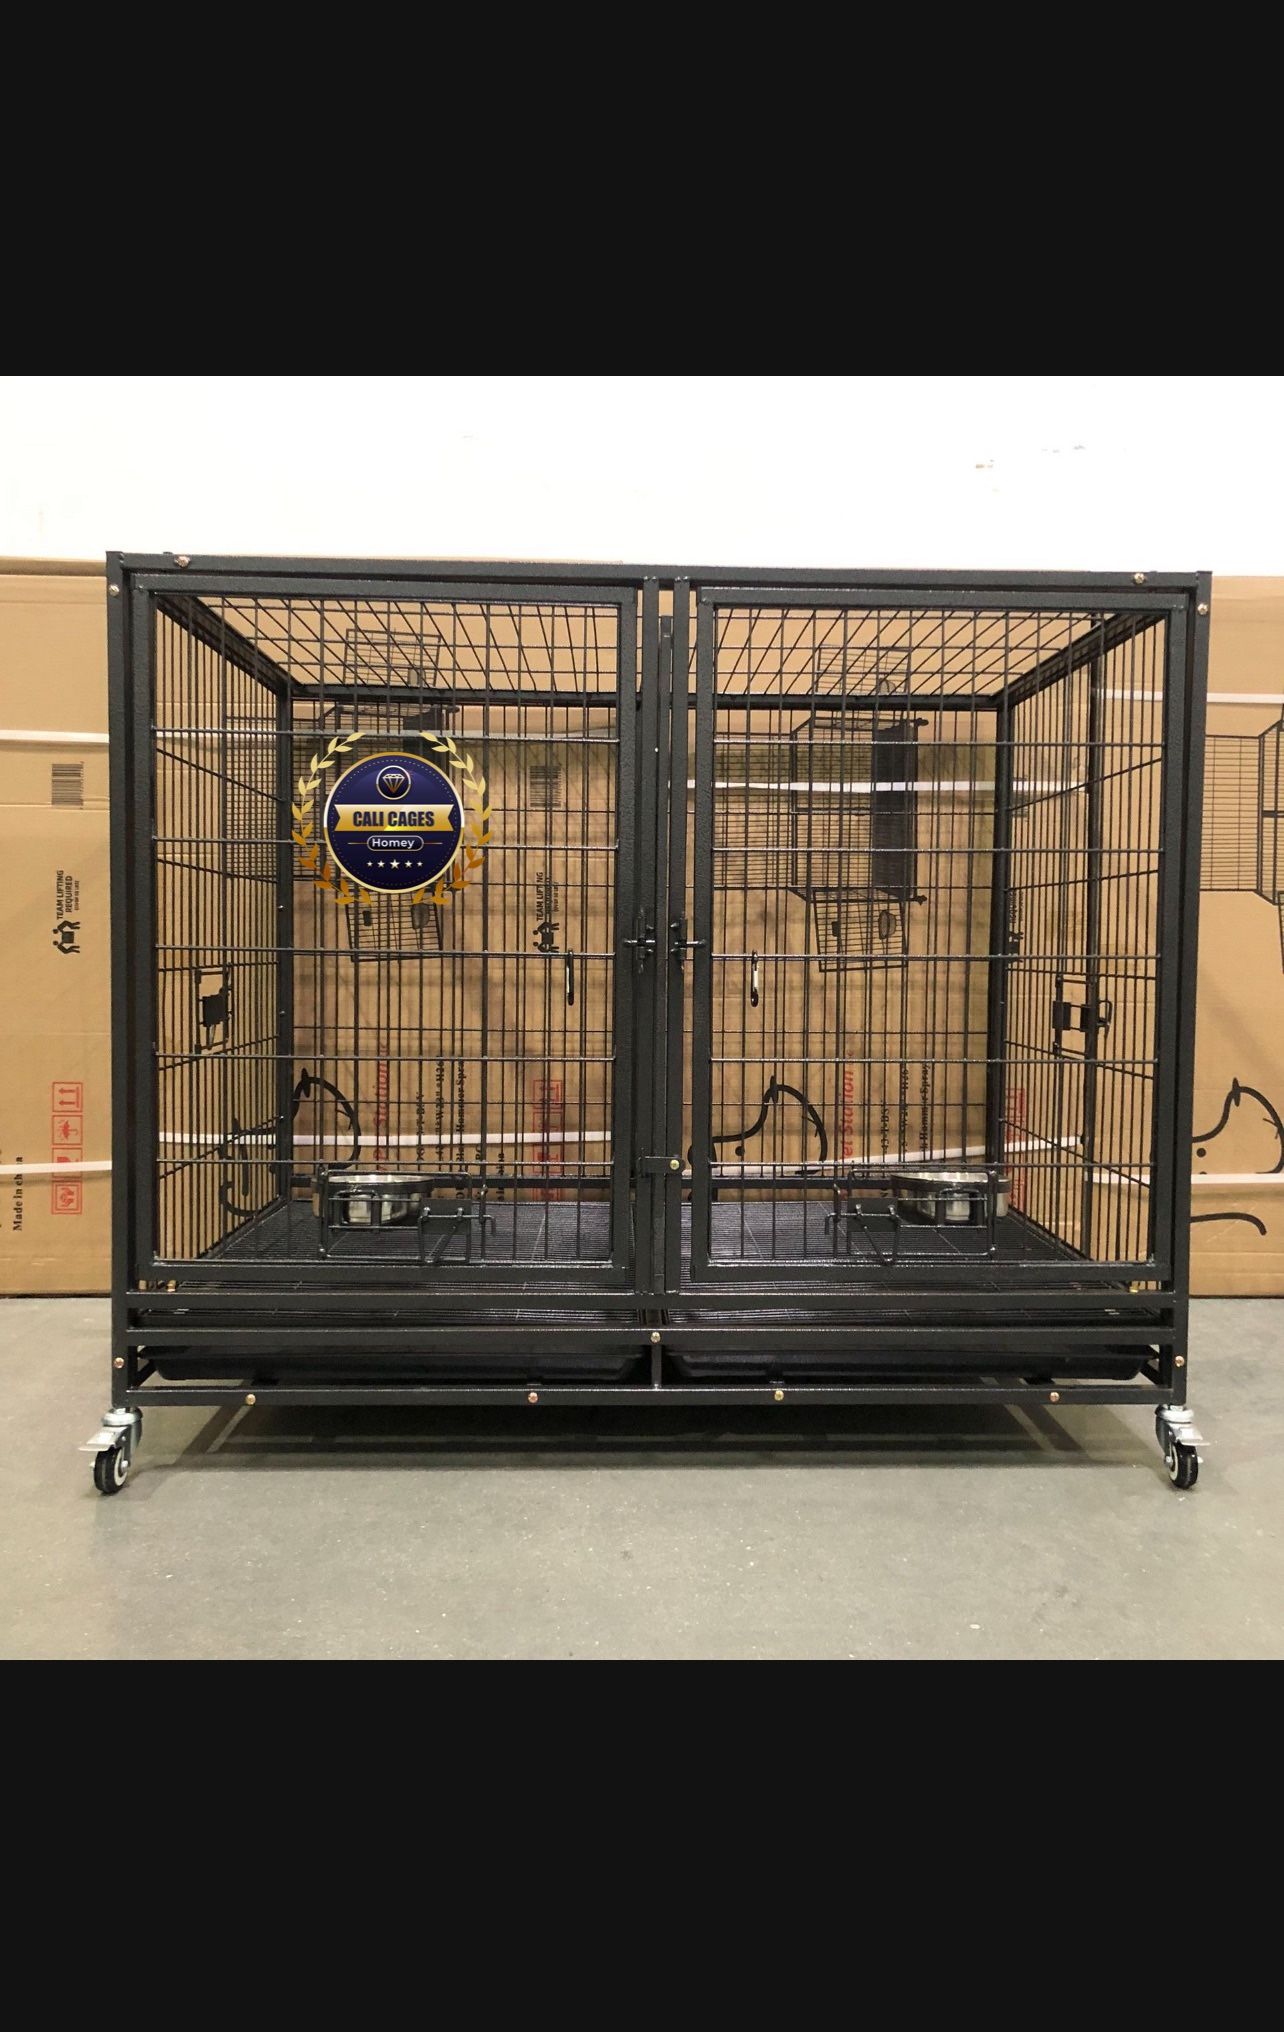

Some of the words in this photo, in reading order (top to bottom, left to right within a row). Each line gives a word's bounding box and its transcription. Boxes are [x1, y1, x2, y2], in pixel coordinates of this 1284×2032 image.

[56, 870, 64, 898] LIFTING
[65, 875, 73, 913] REQUIRED
[536, 872, 544, 900] LIFTNG
[56, 899, 64, 920] TEAM
[536, 901, 544, 921] TEAM
[12, 1188, 22, 1199] in
[12, 1201, 23, 1231] Made
